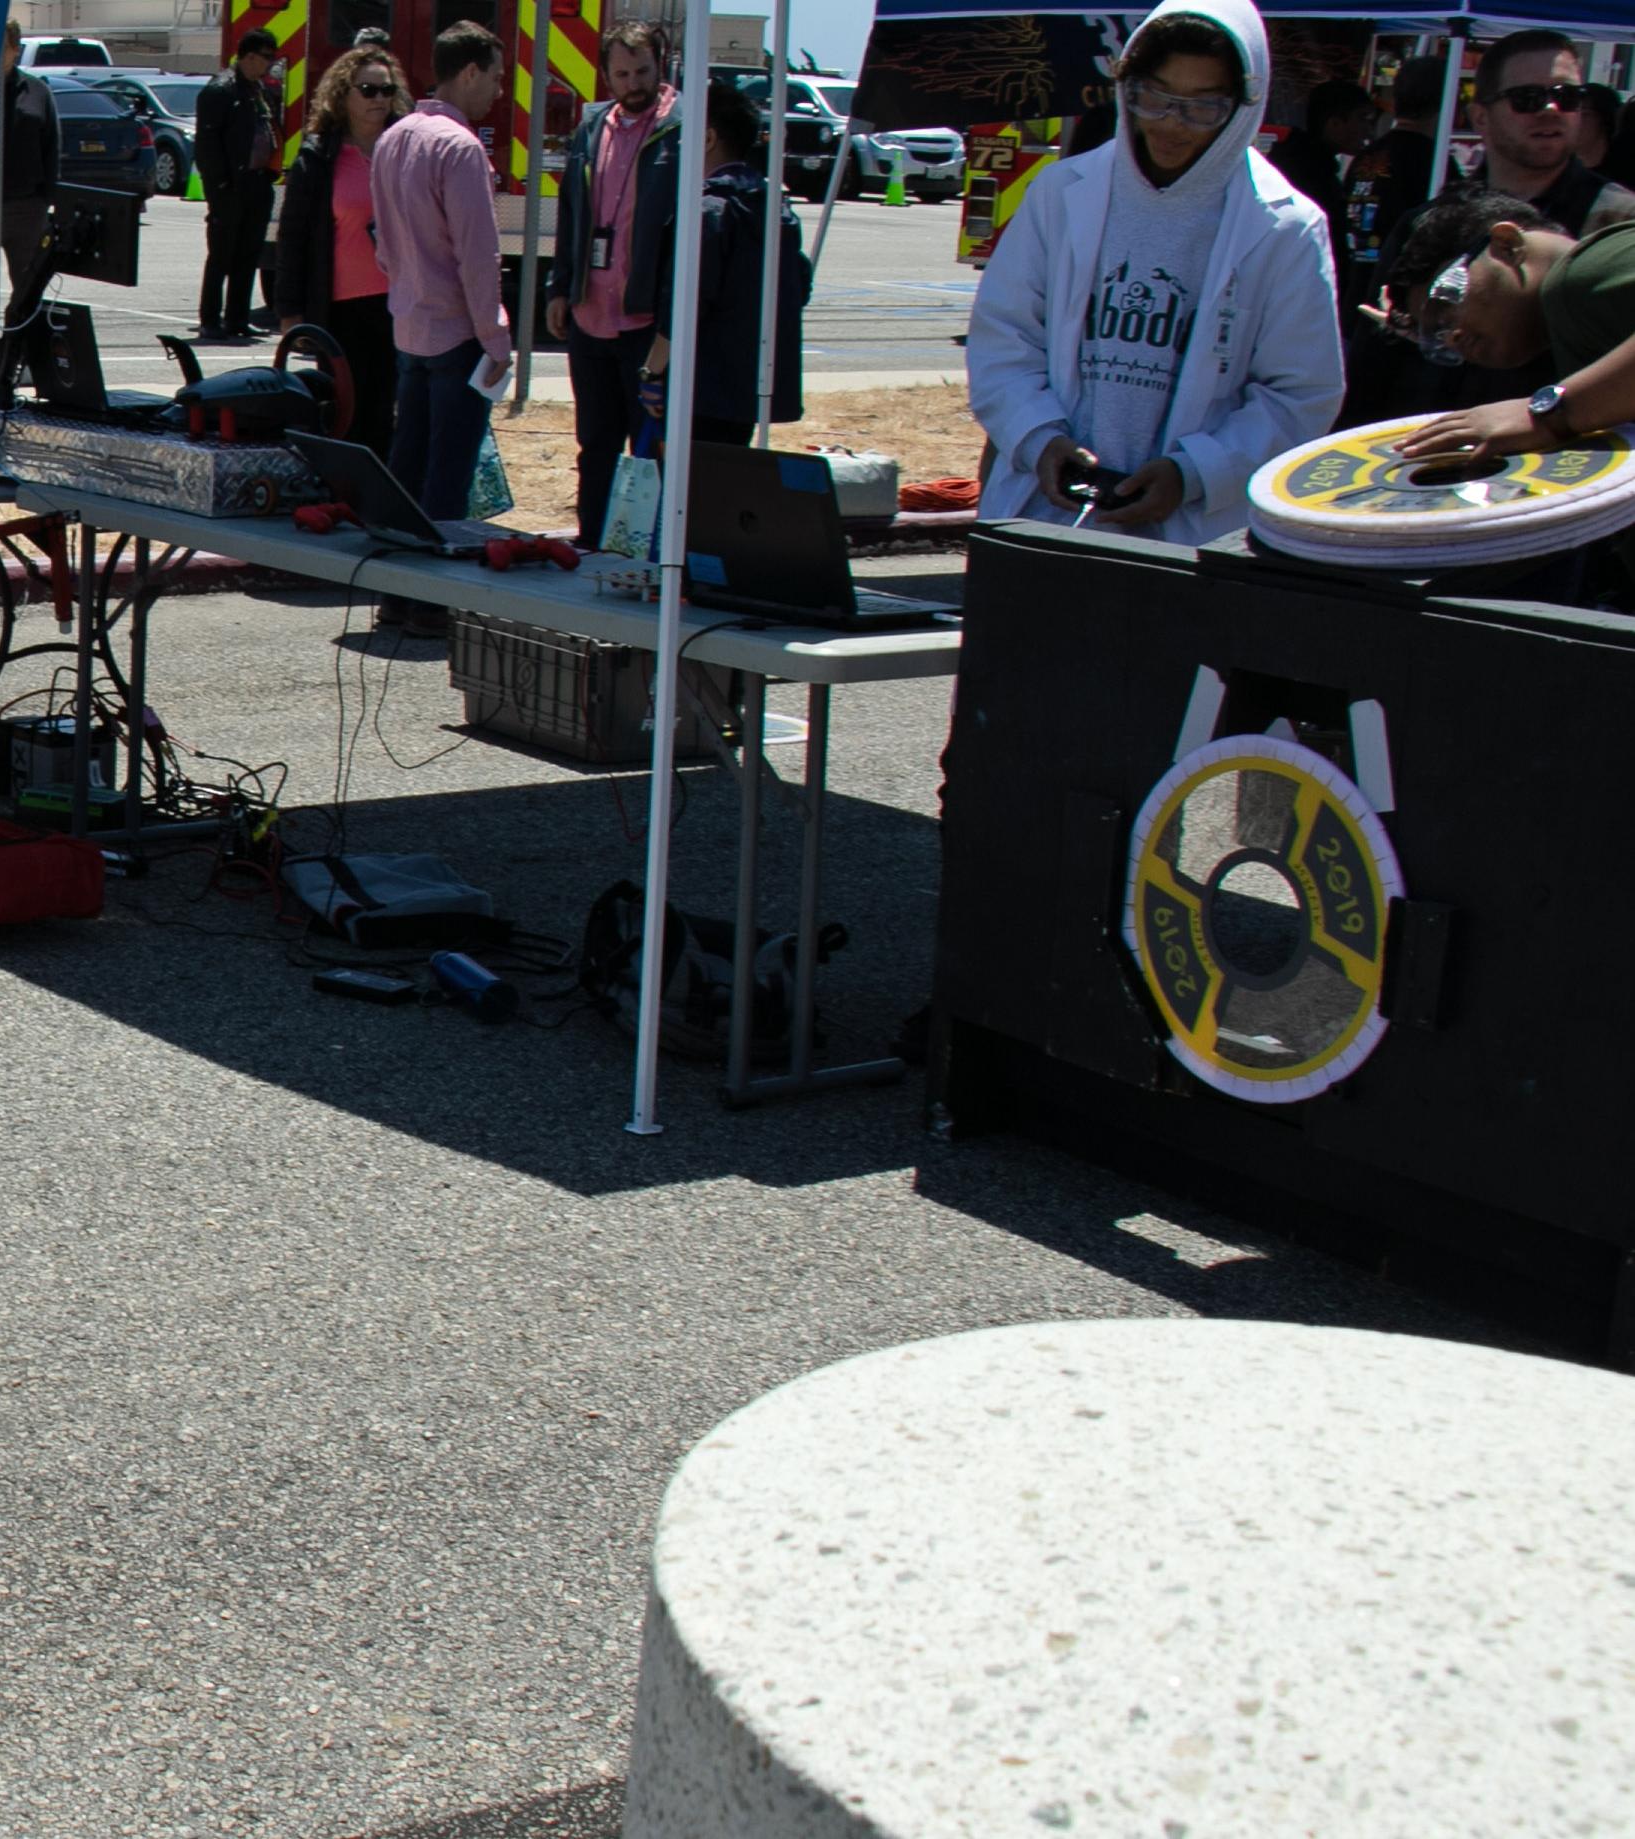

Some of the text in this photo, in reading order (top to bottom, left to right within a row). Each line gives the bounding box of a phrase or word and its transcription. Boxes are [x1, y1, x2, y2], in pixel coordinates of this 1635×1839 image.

[972, 146, 1014, 169] 72
[1303, 456, 1350, 490] 2019
[1315, 836, 1365, 934] 2019
[1153, 907, 1197, 998] 2019
